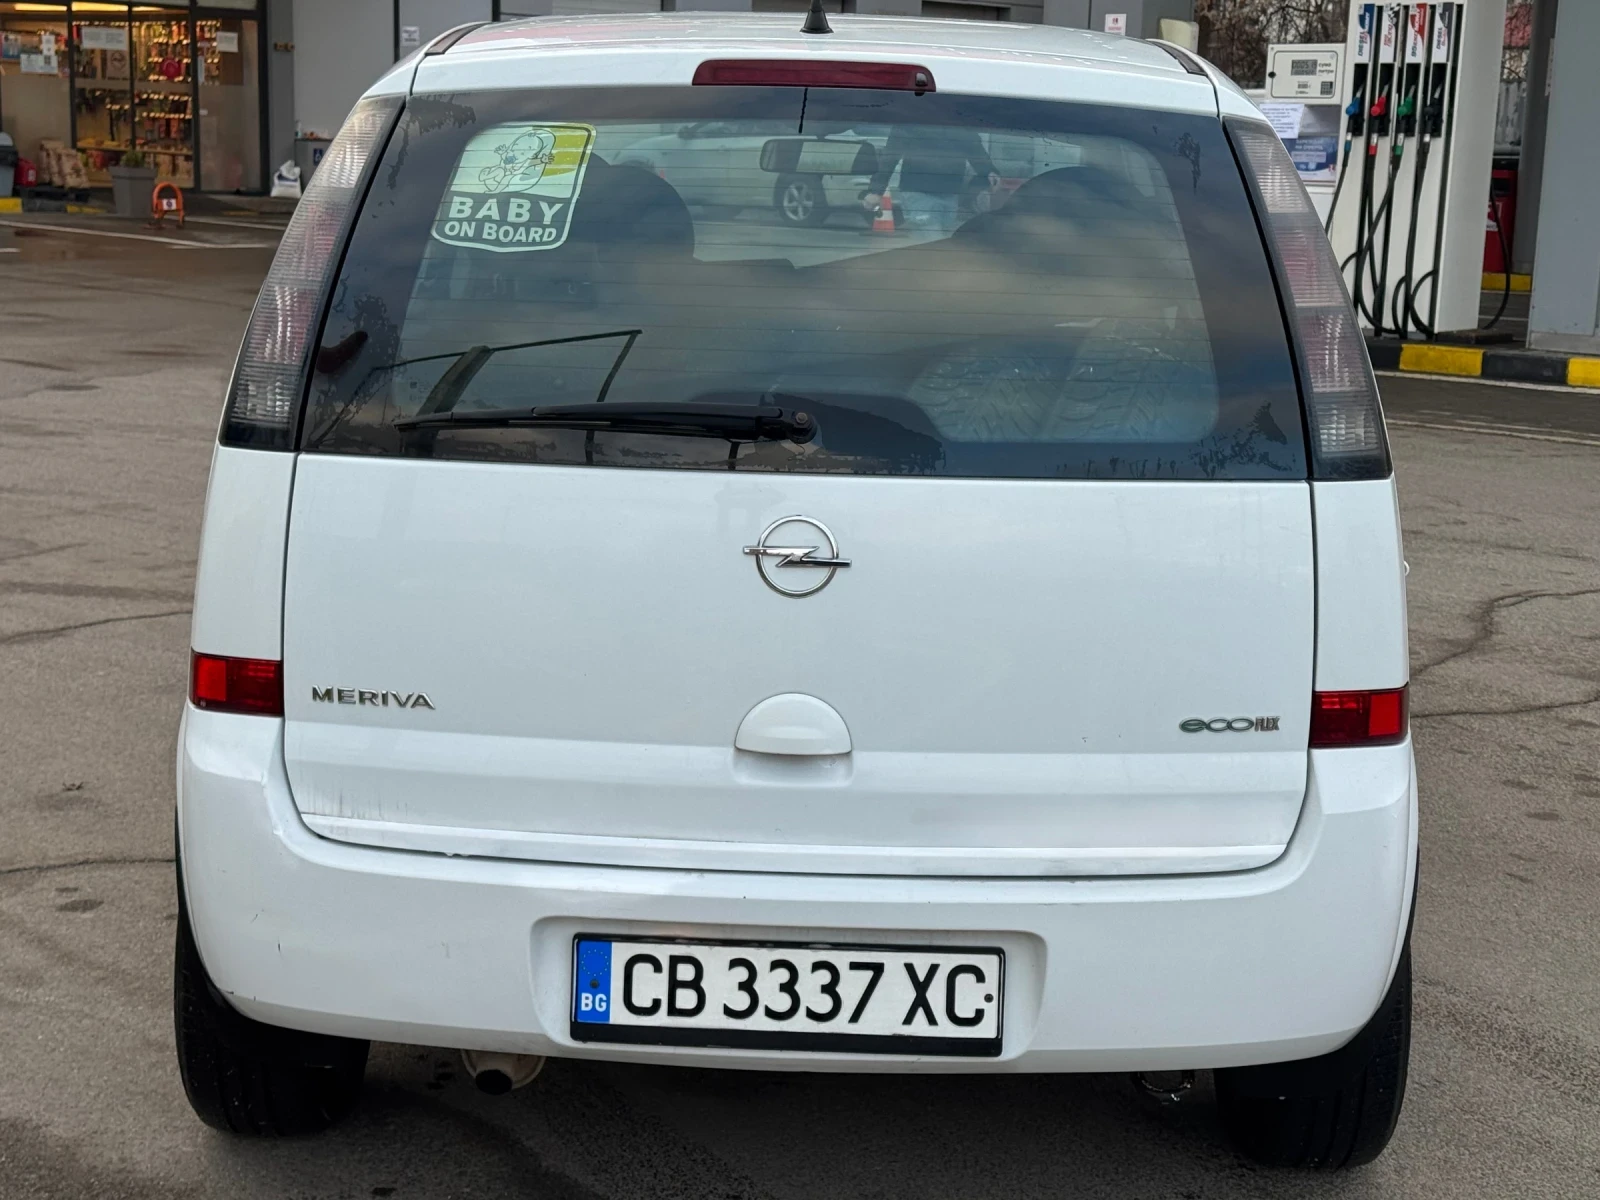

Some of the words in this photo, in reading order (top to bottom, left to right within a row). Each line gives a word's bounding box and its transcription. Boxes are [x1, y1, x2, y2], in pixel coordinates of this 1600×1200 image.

[448, 195, 565, 225] BABY
[444, 221, 476, 237] ON
[482, 223, 557, 243] BOARD
[311, 684, 436, 710] MERIVA
[580, 992, 608, 1013] BG
[622, 953, 707, 1018] CB
[722, 956, 885, 1025] 3337
[901, 961, 987, 1028] XC
